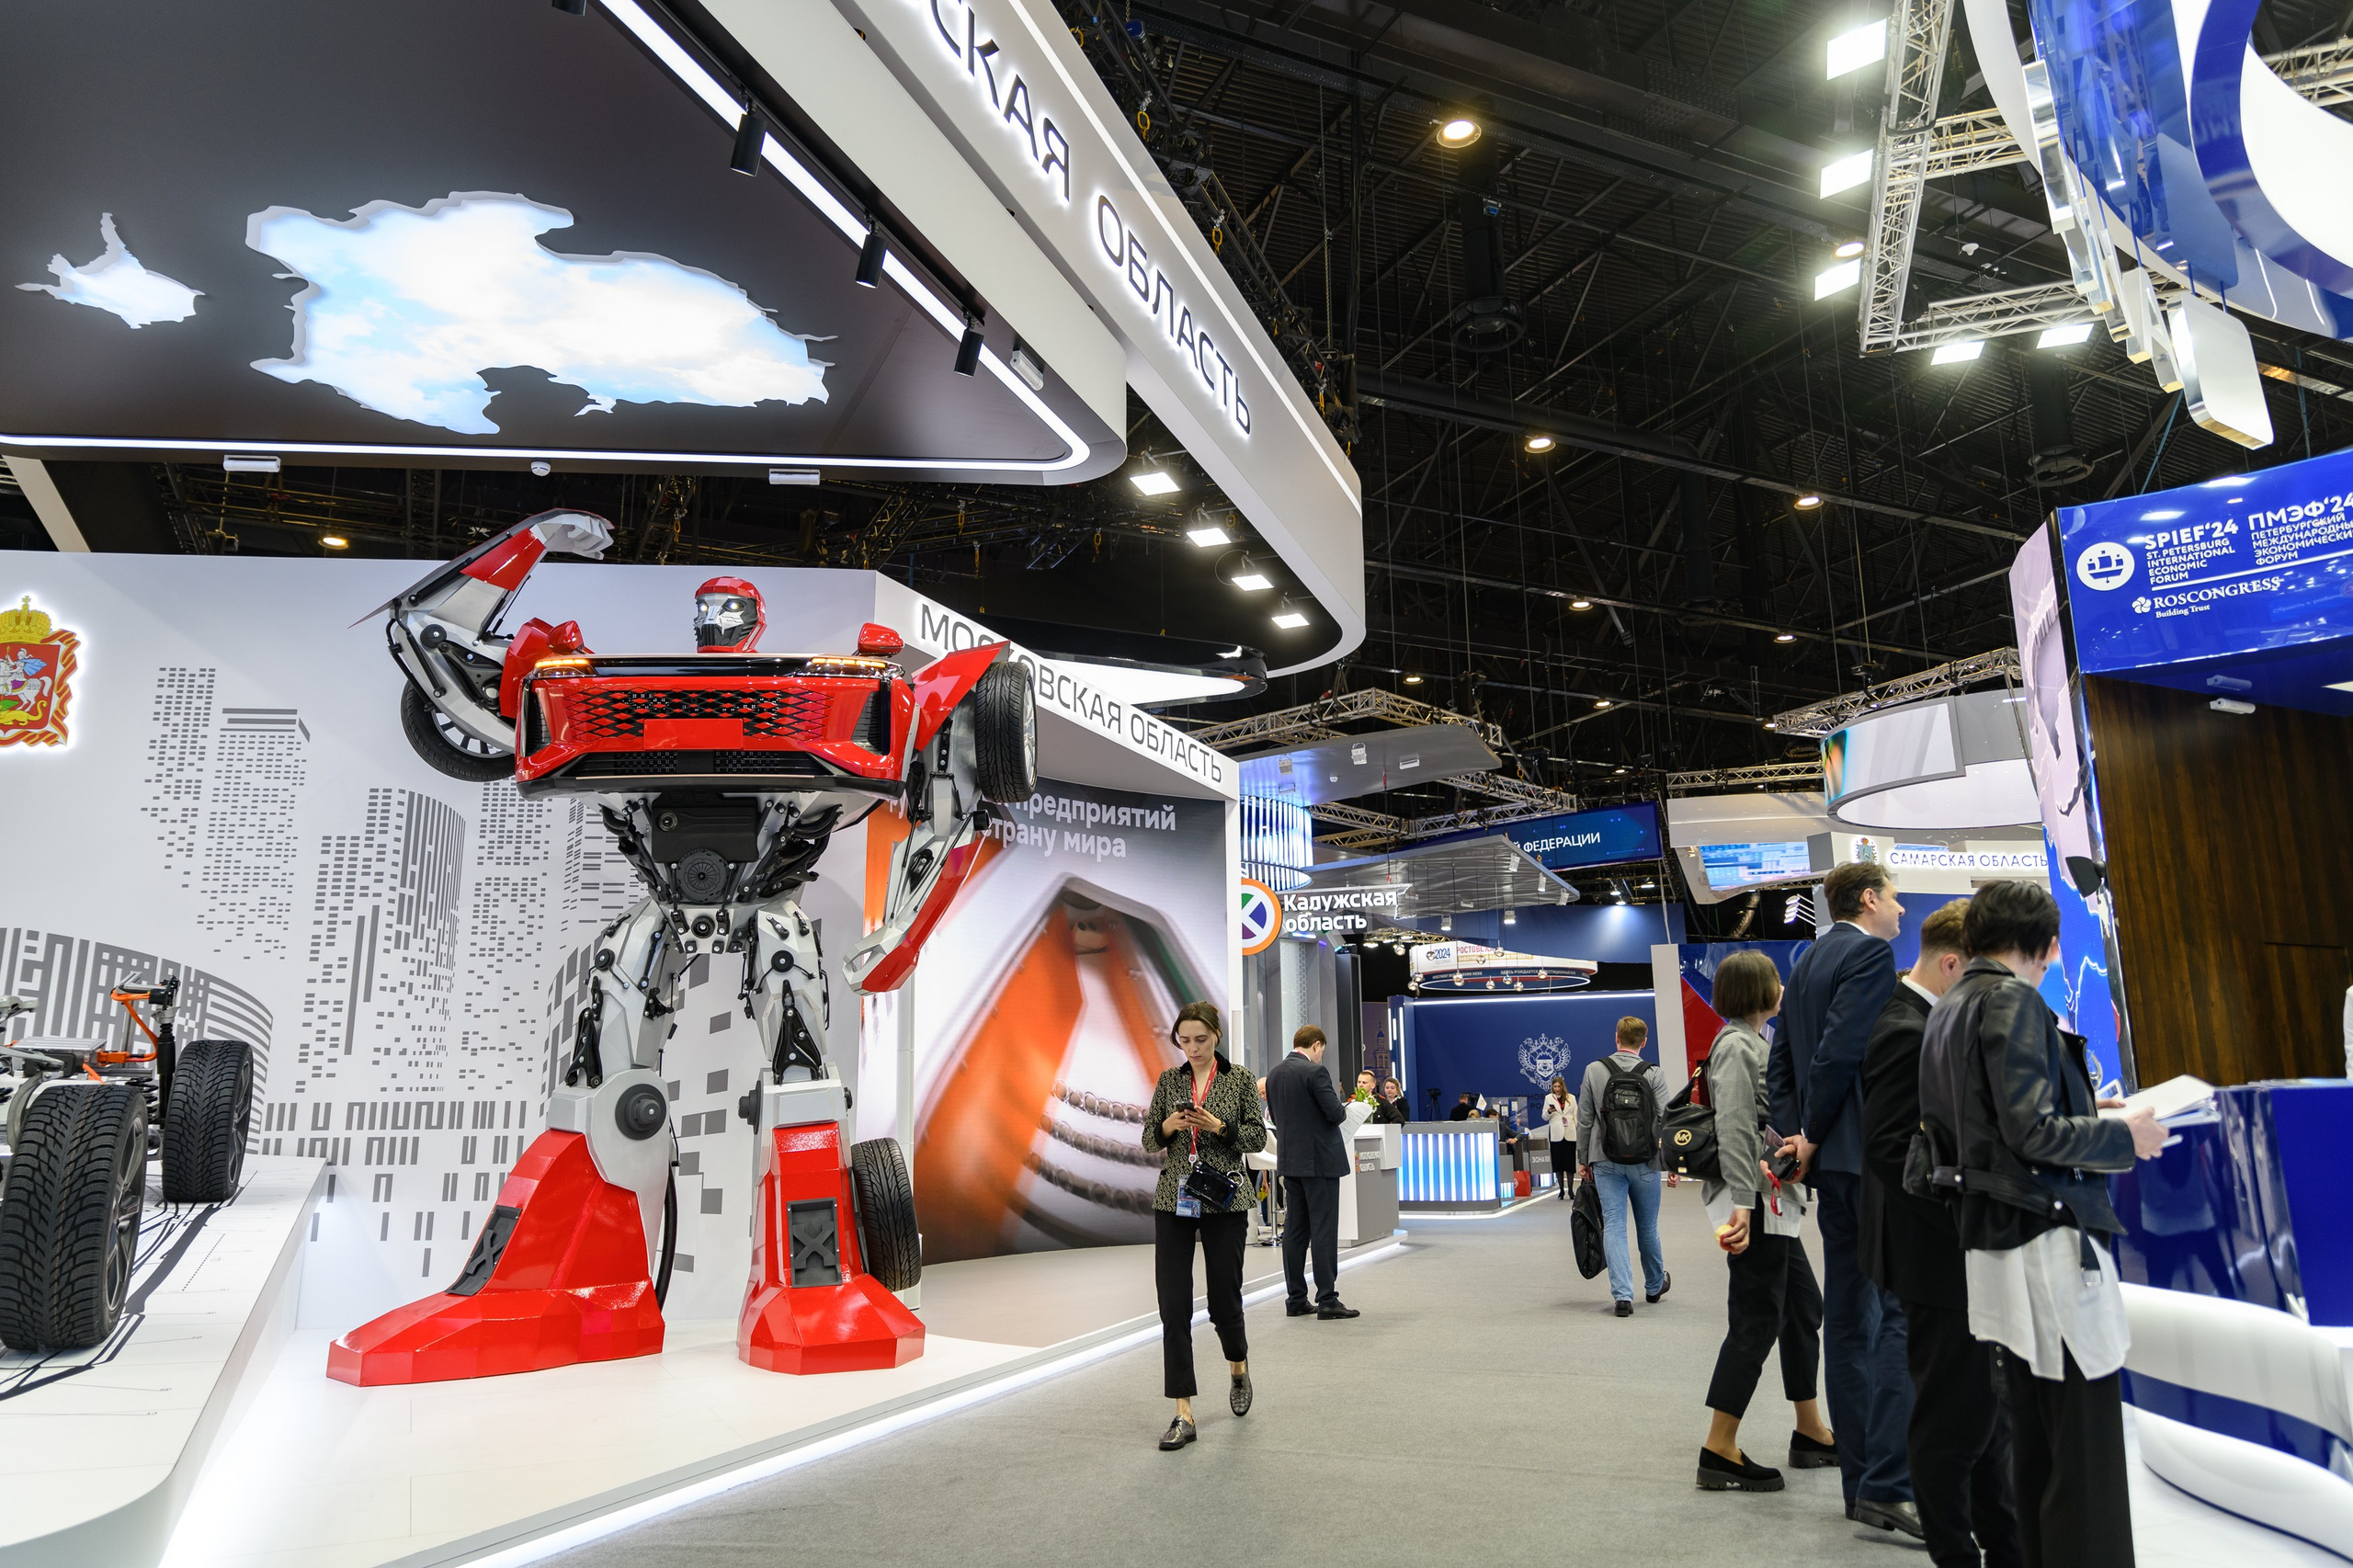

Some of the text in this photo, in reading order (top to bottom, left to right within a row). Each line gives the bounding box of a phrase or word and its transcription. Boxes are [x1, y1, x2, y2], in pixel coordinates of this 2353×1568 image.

[1097, 194, 1252, 436] ОБЛАСТЬ
[2251, 512, 2346, 540] ПЕТЕРБУРГСКИЙ
[2146, 538, 2230, 560] ST. PETERSBURG
[2254, 529, 2353, 558] ЭКОНОМИЧЕСКИ
[2147, 546, 2235, 568] INTERNATIONAL
[2149, 560, 2208, 576] ECONOMIC
[2256, 551, 2298, 566] ФОРУМ
[2150, 571, 2189, 585] FORUM
[2153, 575, 2281, 609] ROSCONGRESS
[2155, 604, 2211, 619] Building Trust
[921, 603, 1222, 783] МООВСКАЯ ОБЛАСТЬ
[1064, 831, 1126, 862] мира
[1523, 832, 1601, 854] ФЕДЕРАЦИИ
[1890, 851, 2048, 868] САМАРСКАЯ ОБЛАСТЬ
[1283, 891, 1398, 913] Калужская
[1286, 912, 1368, 932] область
[1435, 948, 1450, 960] 2024
